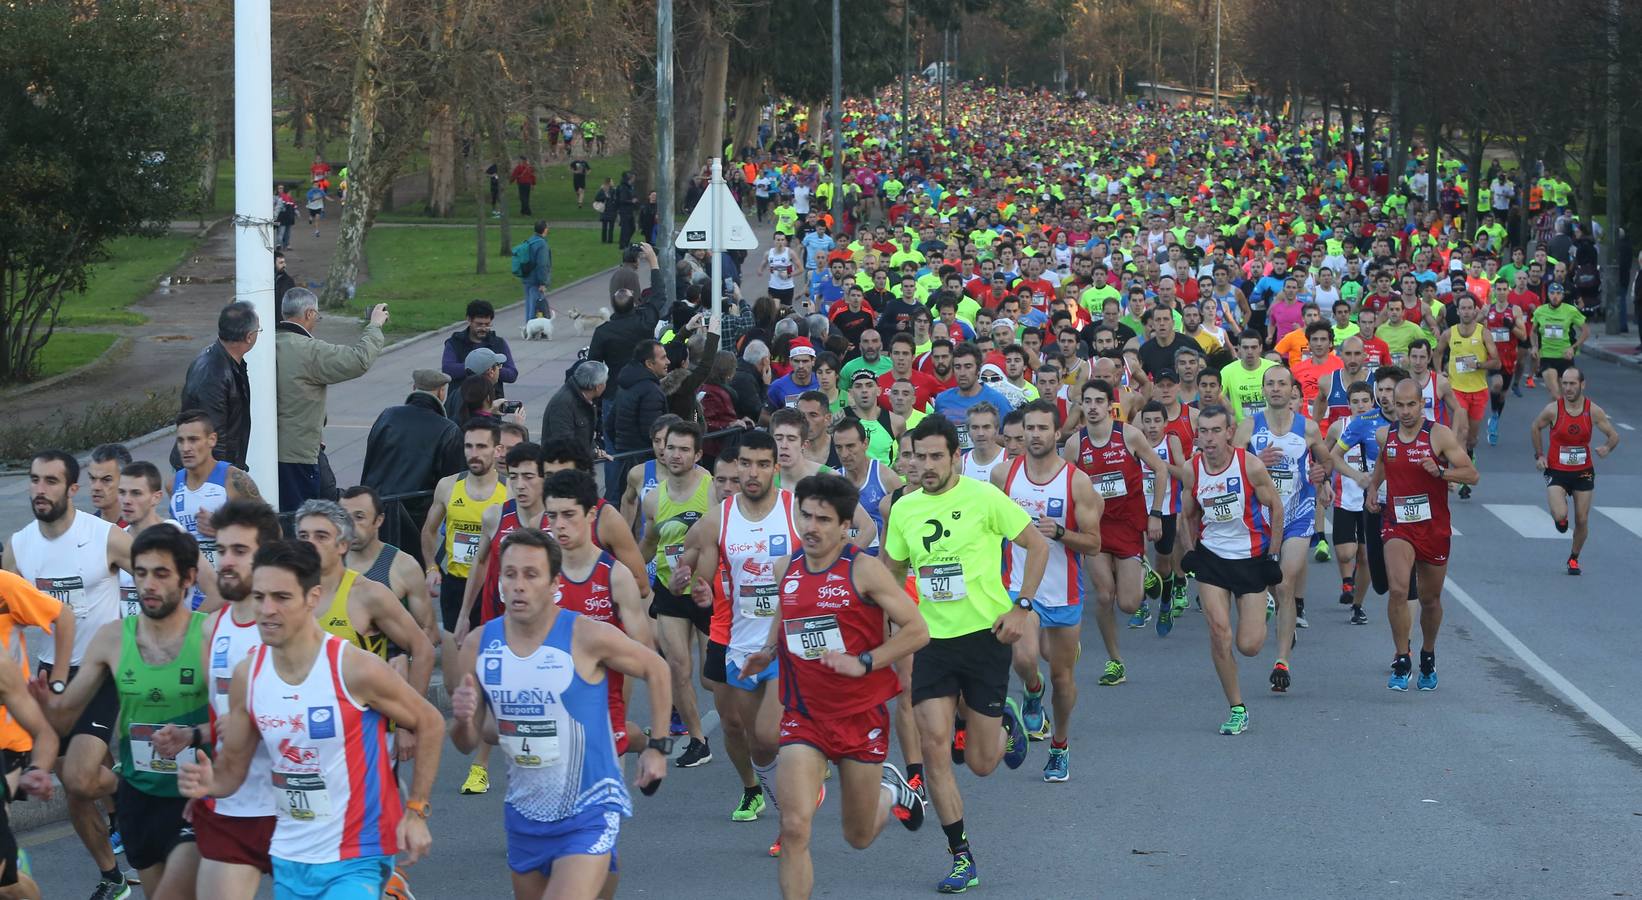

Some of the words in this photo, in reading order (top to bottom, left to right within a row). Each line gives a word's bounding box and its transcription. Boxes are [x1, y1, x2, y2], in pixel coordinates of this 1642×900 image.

[1101, 481, 1116, 491] 402
[1213, 505, 1230, 516] 376
[1403, 505, 1419, 516] 397
[931, 578, 950, 591] 527
[818, 584, 849, 599] gijón
[756, 597, 770, 609] 46
[801, 632, 826, 649] 600
[491, 688, 557, 705] PILOÑA
[504, 705, 541, 716] deporte
[522, 738, 531, 755] 4
[286, 791, 310, 809] 371
